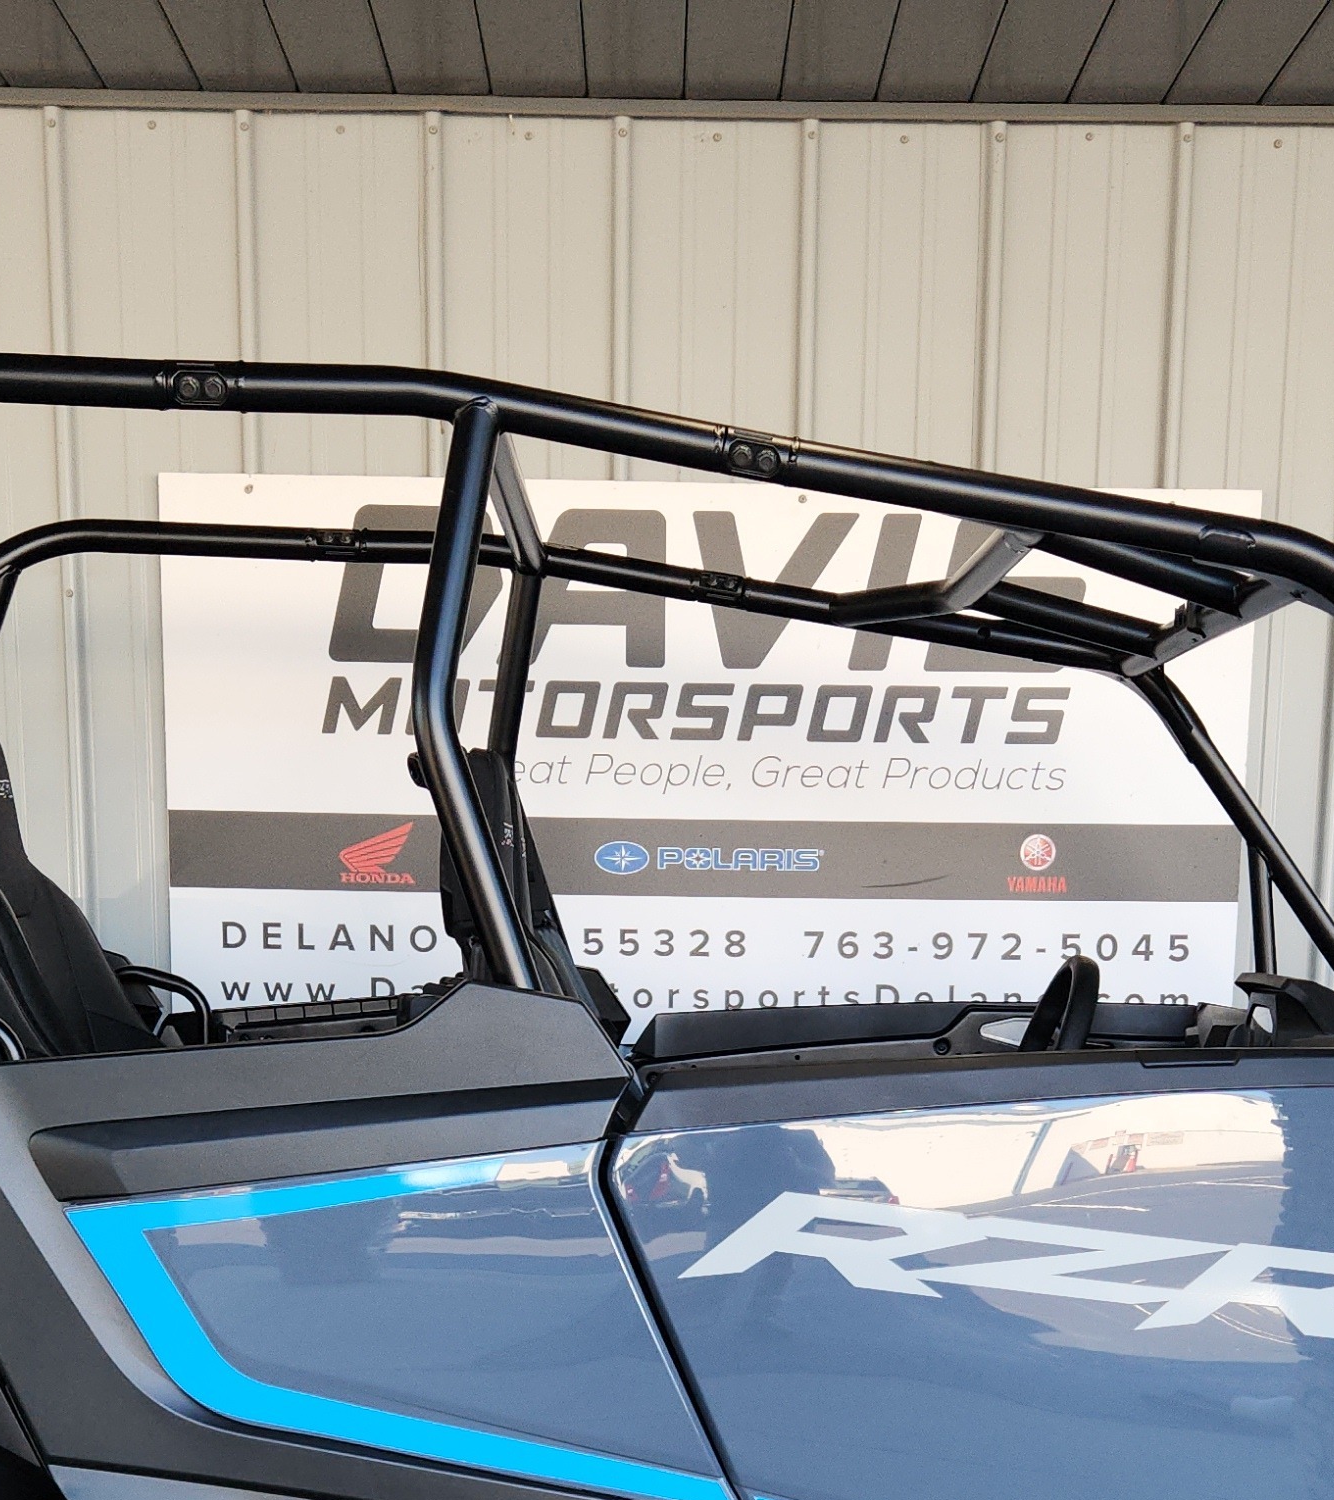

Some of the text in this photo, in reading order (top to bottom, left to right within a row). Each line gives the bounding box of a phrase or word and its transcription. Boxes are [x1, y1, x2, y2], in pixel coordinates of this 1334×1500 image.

[322, 676, 1071, 745] MORSPORTS
[515, 753, 1067, 795] eat People, Great Products
[657, 846, 820, 872] POLARIS
[340, 872, 416, 884] HONDA
[1007, 875, 1067, 893] YAMAHA
[222, 921, 438, 954] DELANO
[583, 927, 1190, 963] 55328 763-972-5045
